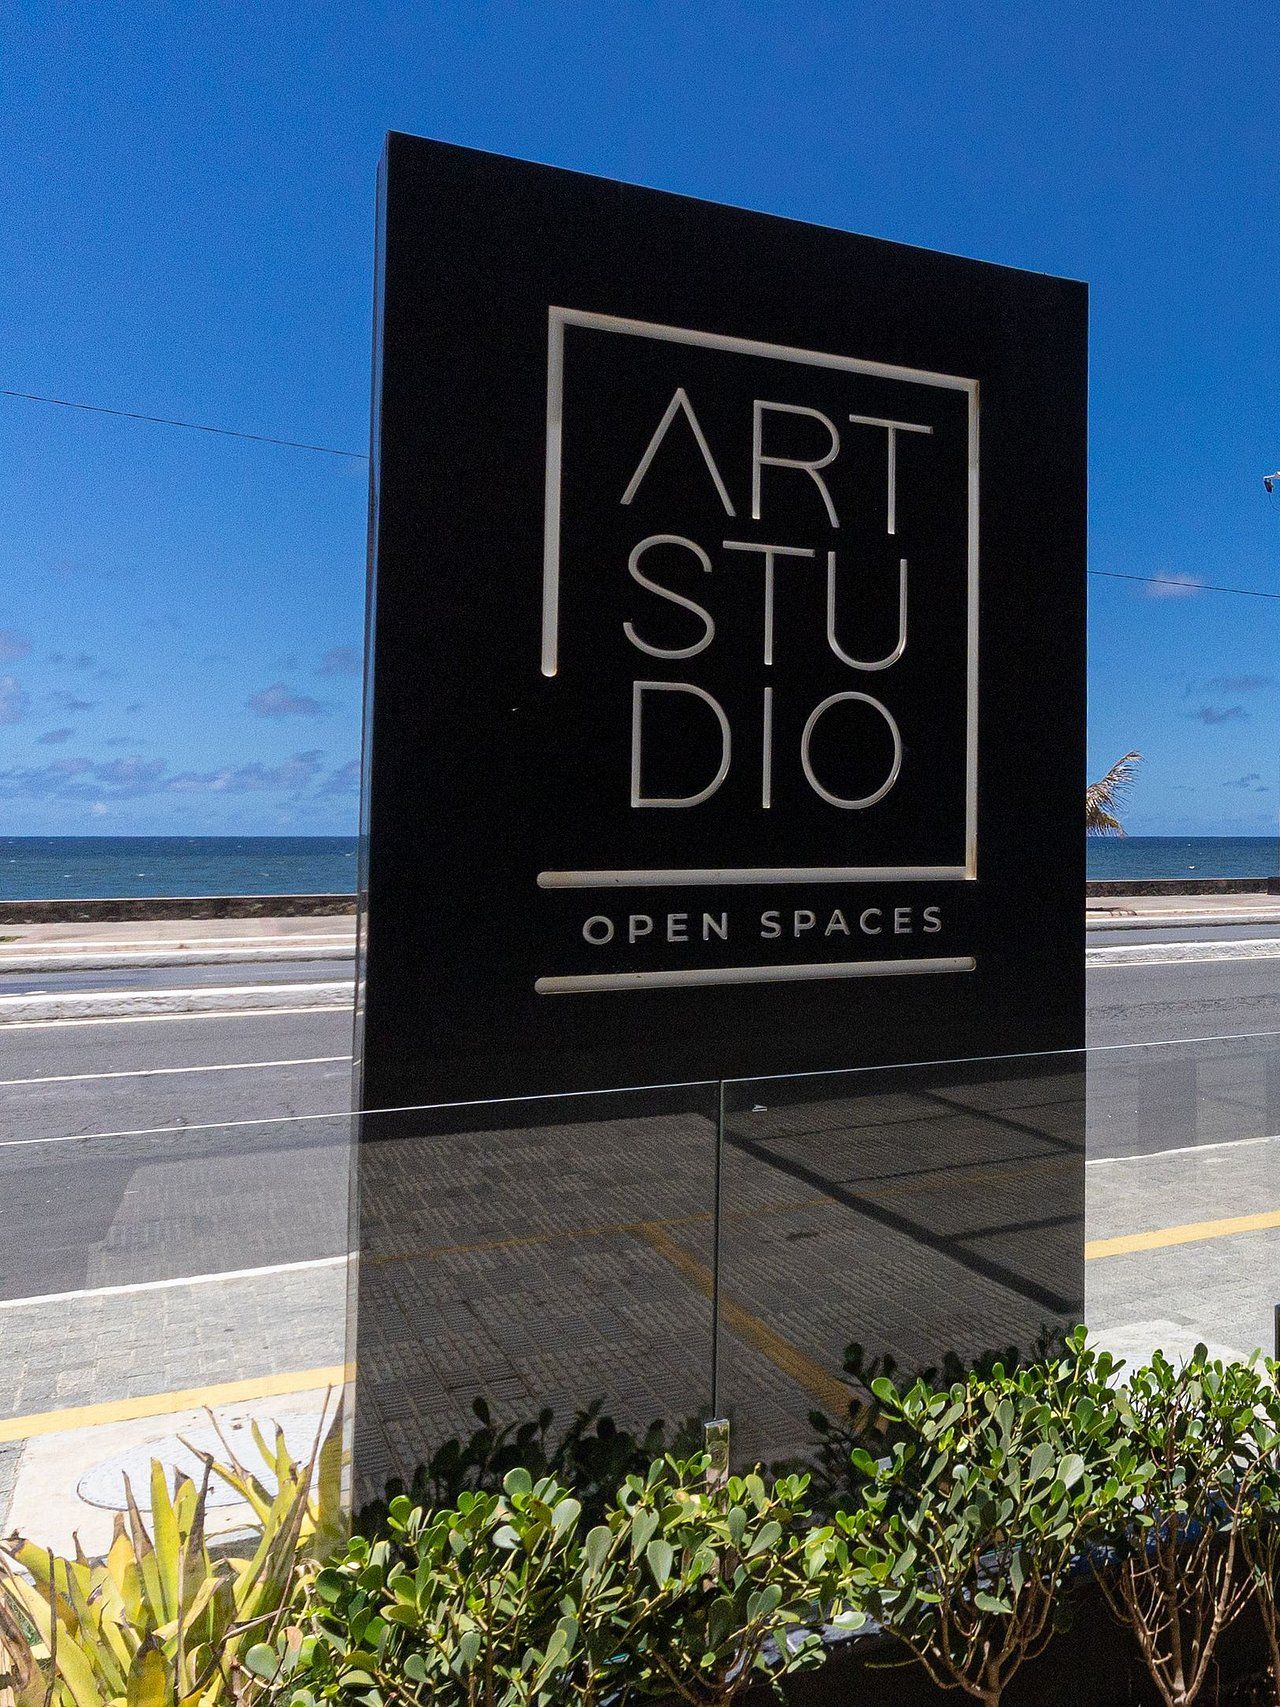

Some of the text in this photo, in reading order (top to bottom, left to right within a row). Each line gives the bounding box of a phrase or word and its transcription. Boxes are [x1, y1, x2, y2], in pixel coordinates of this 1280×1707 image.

[620, 387, 933, 536] ART
[622, 534, 908, 672] STU
[630, 680, 902, 810] DIO
[582, 906, 943, 945] OPEN SPACES
